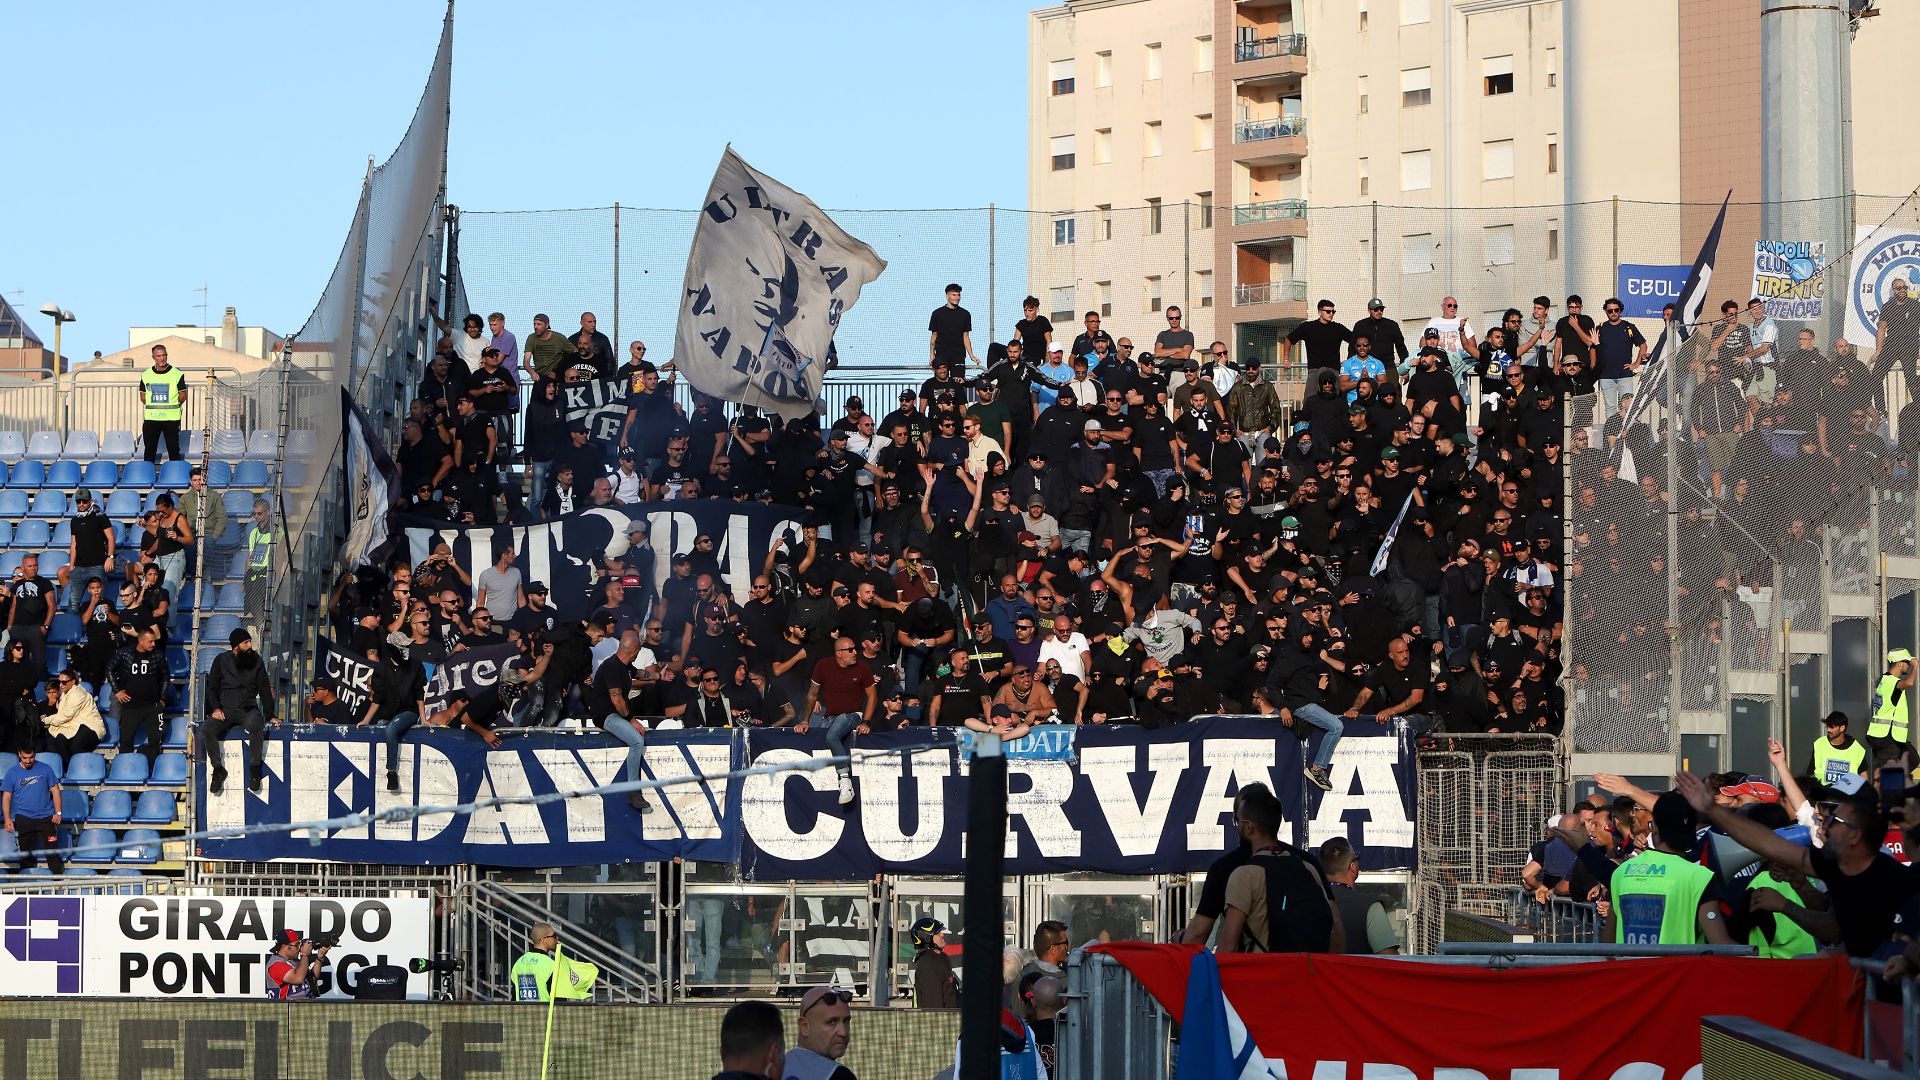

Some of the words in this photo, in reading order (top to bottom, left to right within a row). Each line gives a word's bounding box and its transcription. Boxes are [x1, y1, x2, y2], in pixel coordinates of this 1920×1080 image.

[1757, 241, 1810, 259] NAPOLI
[1628, 279, 1687, 296] EBOL
[206, 739, 731, 845] FEDAYN
[741, 738, 1293, 862] CURVA
[119, 899, 392, 942] GIRALDO
